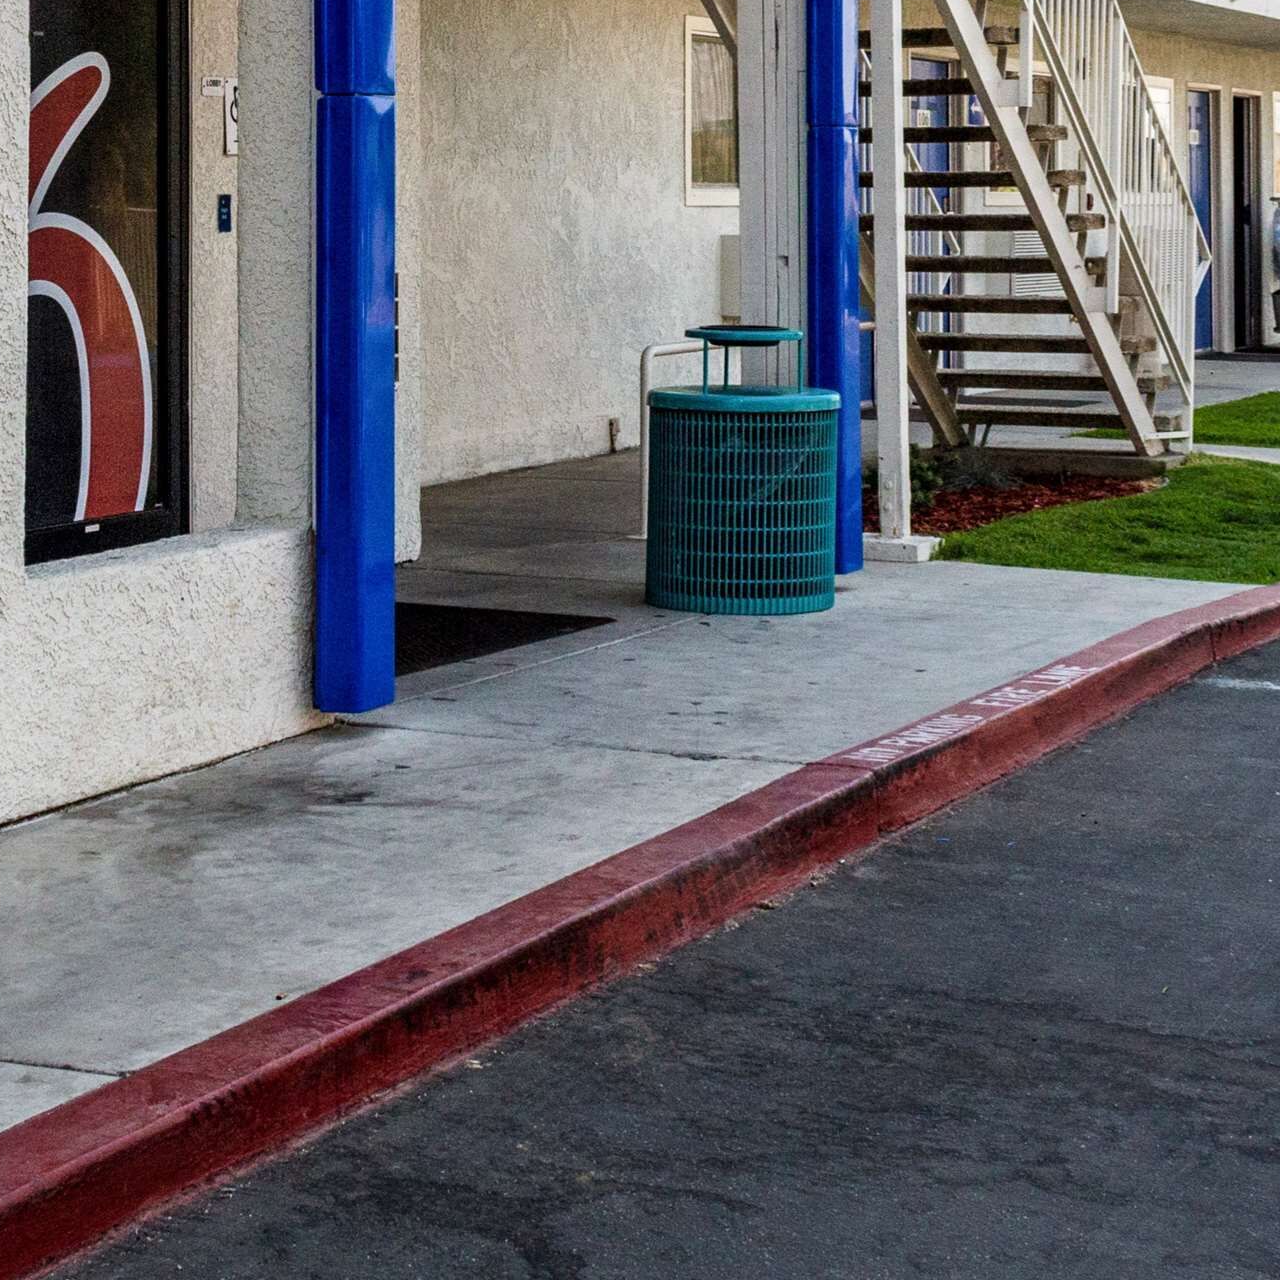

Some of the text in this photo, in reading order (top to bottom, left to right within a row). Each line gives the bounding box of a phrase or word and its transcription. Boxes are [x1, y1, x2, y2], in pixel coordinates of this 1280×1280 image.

[206, 79, 222, 87] LOBBY
[840, 747, 904, 763] NO
[877, 713, 985, 748] PARKING
[969, 686, 1048, 708] FIRE
